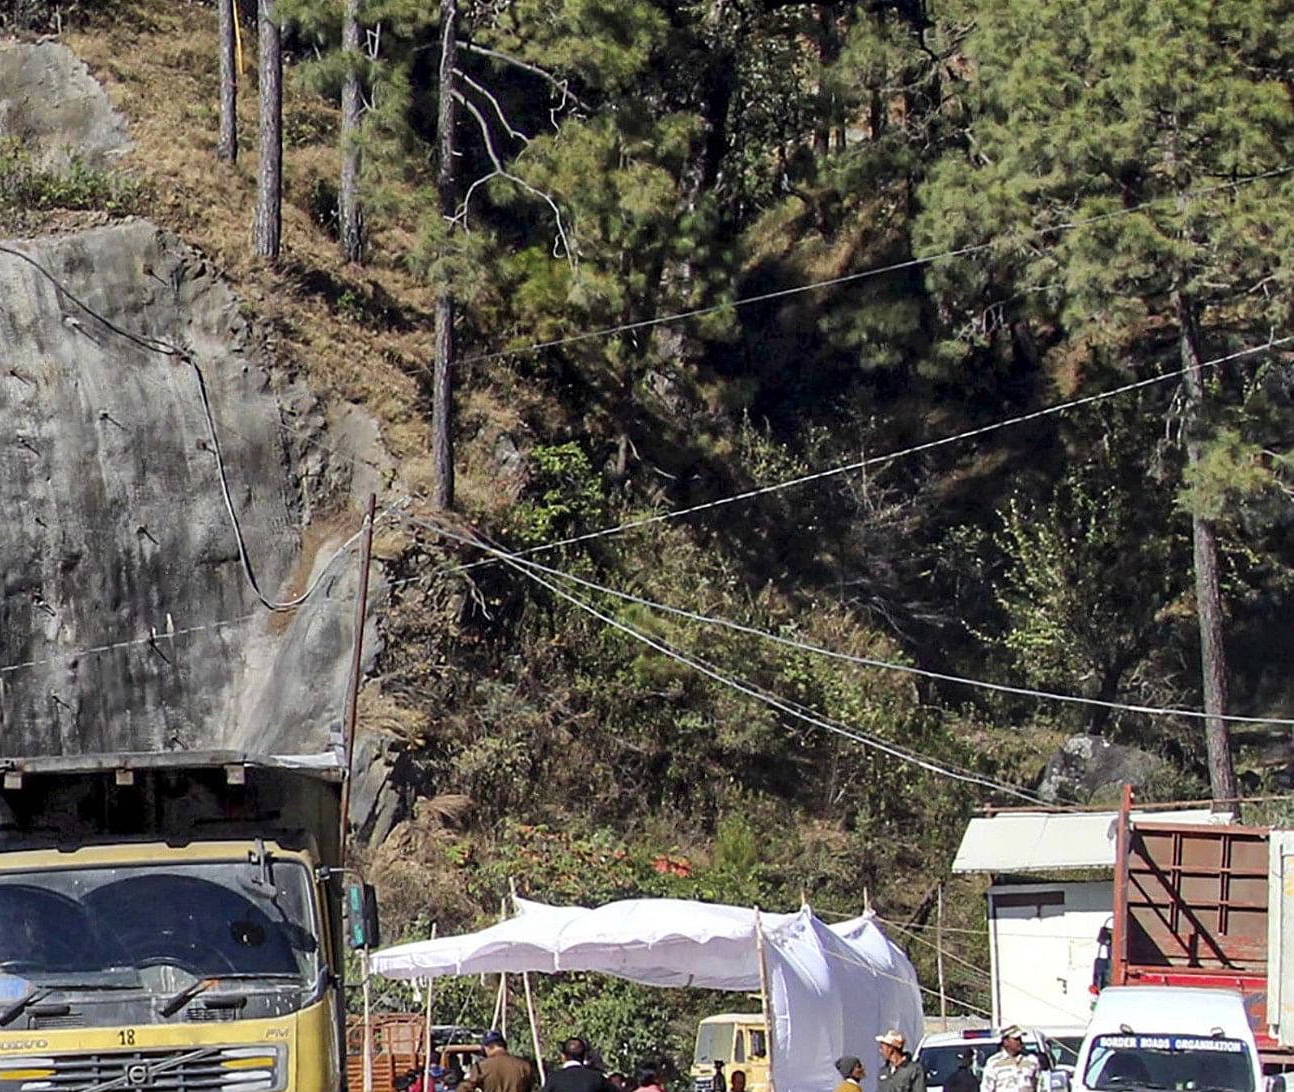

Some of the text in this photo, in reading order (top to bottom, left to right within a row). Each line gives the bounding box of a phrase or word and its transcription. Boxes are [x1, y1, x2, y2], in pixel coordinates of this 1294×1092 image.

[117, 1029, 136, 1046] 18
[1099, 1037, 1242, 1052] BORDER ROADS ORGANISATION
